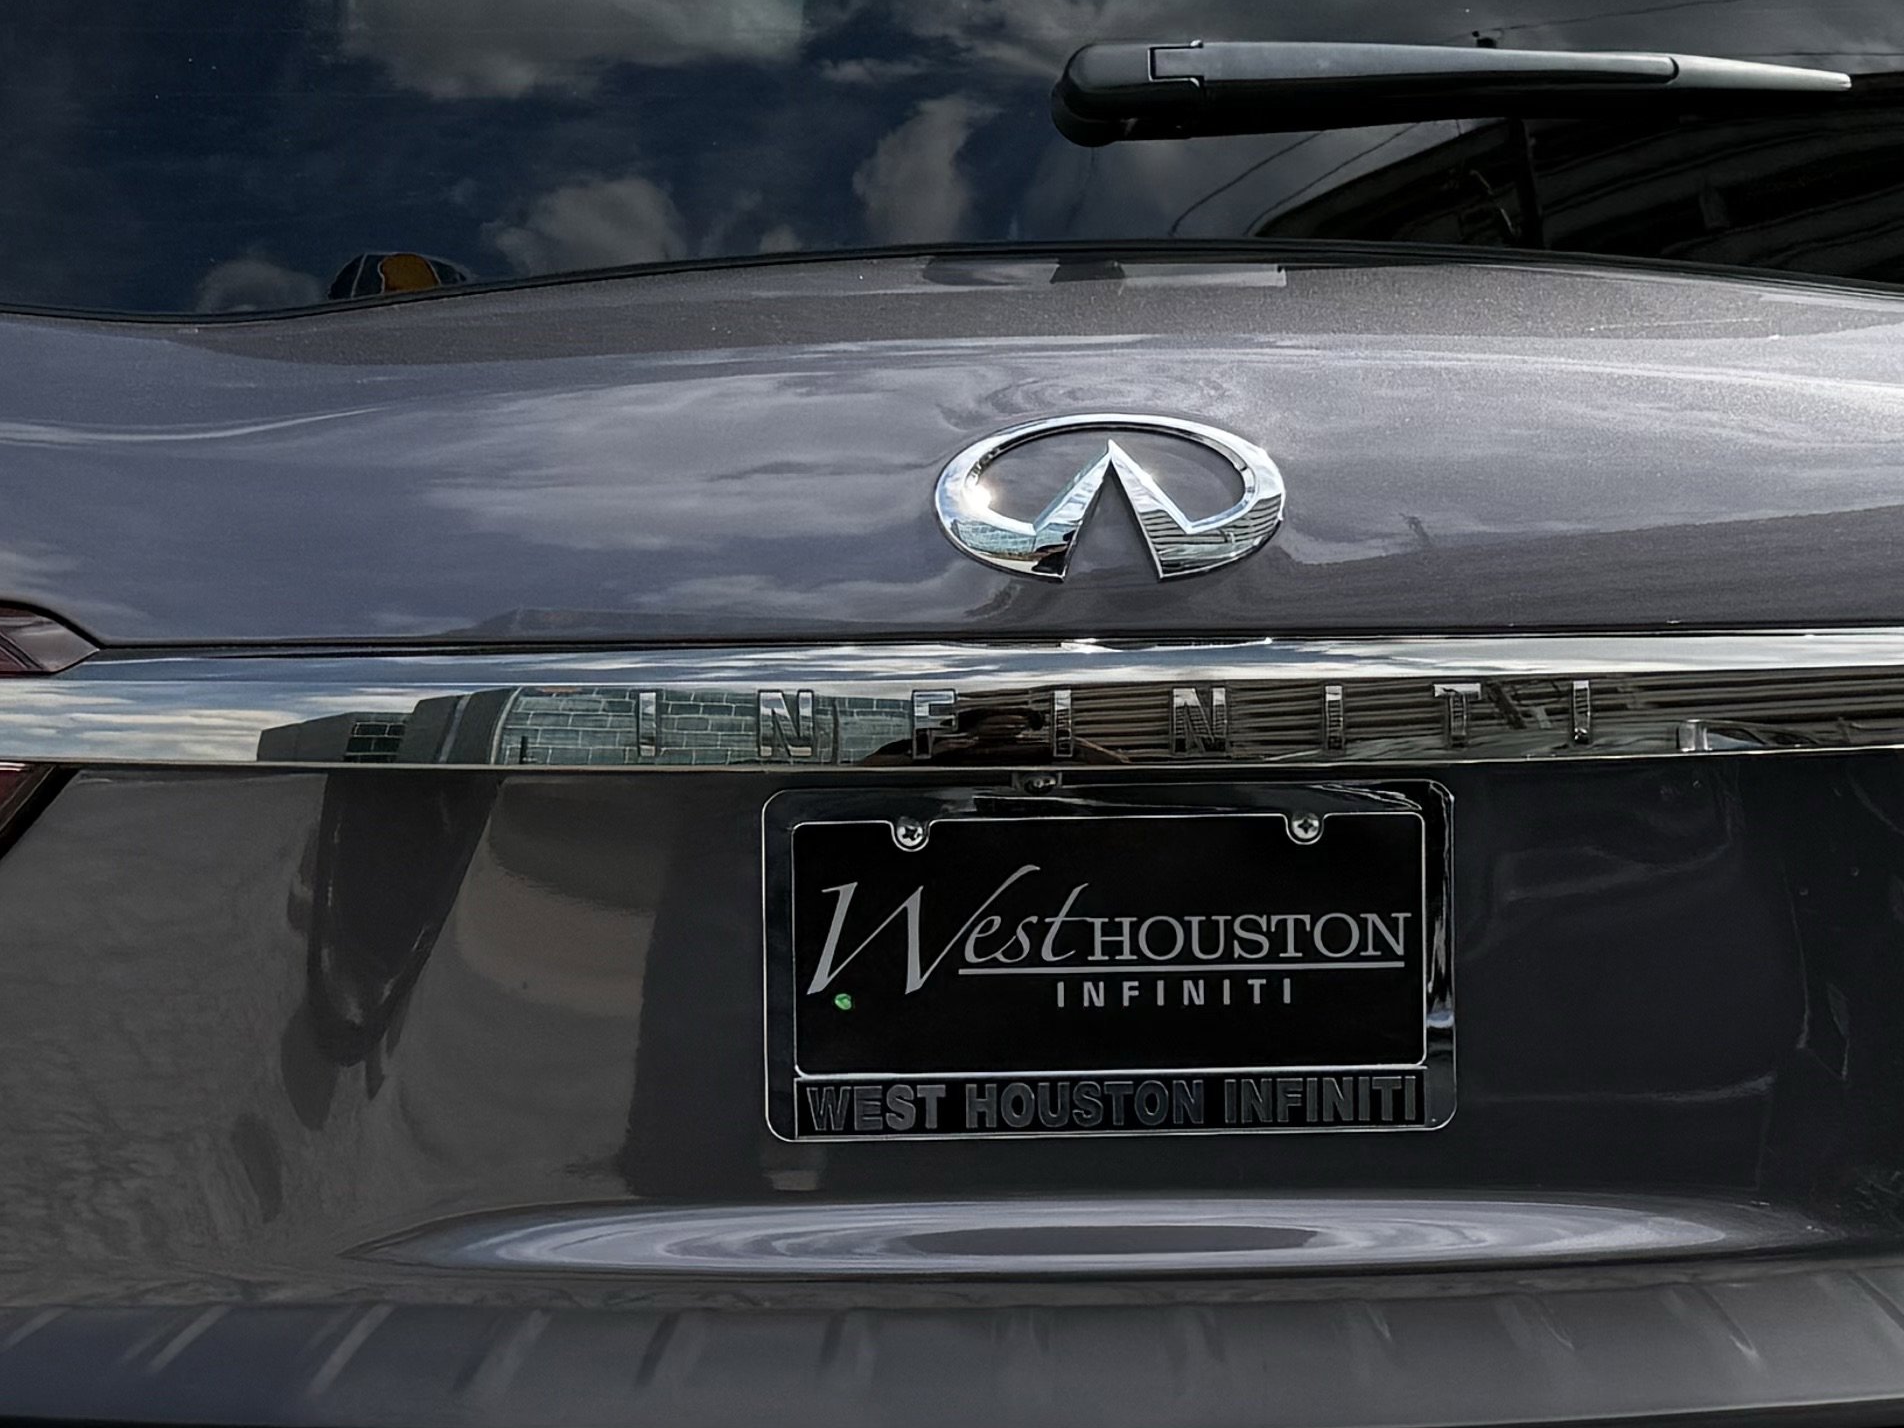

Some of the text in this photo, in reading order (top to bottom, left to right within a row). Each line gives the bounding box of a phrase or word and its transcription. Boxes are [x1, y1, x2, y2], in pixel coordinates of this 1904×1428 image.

[635, 679, 1592, 760] INFINITI
[1056, 976, 1295, 1009] INFINITI
[805, 1073, 1419, 1134] WEST HOUSTON INFINITI
